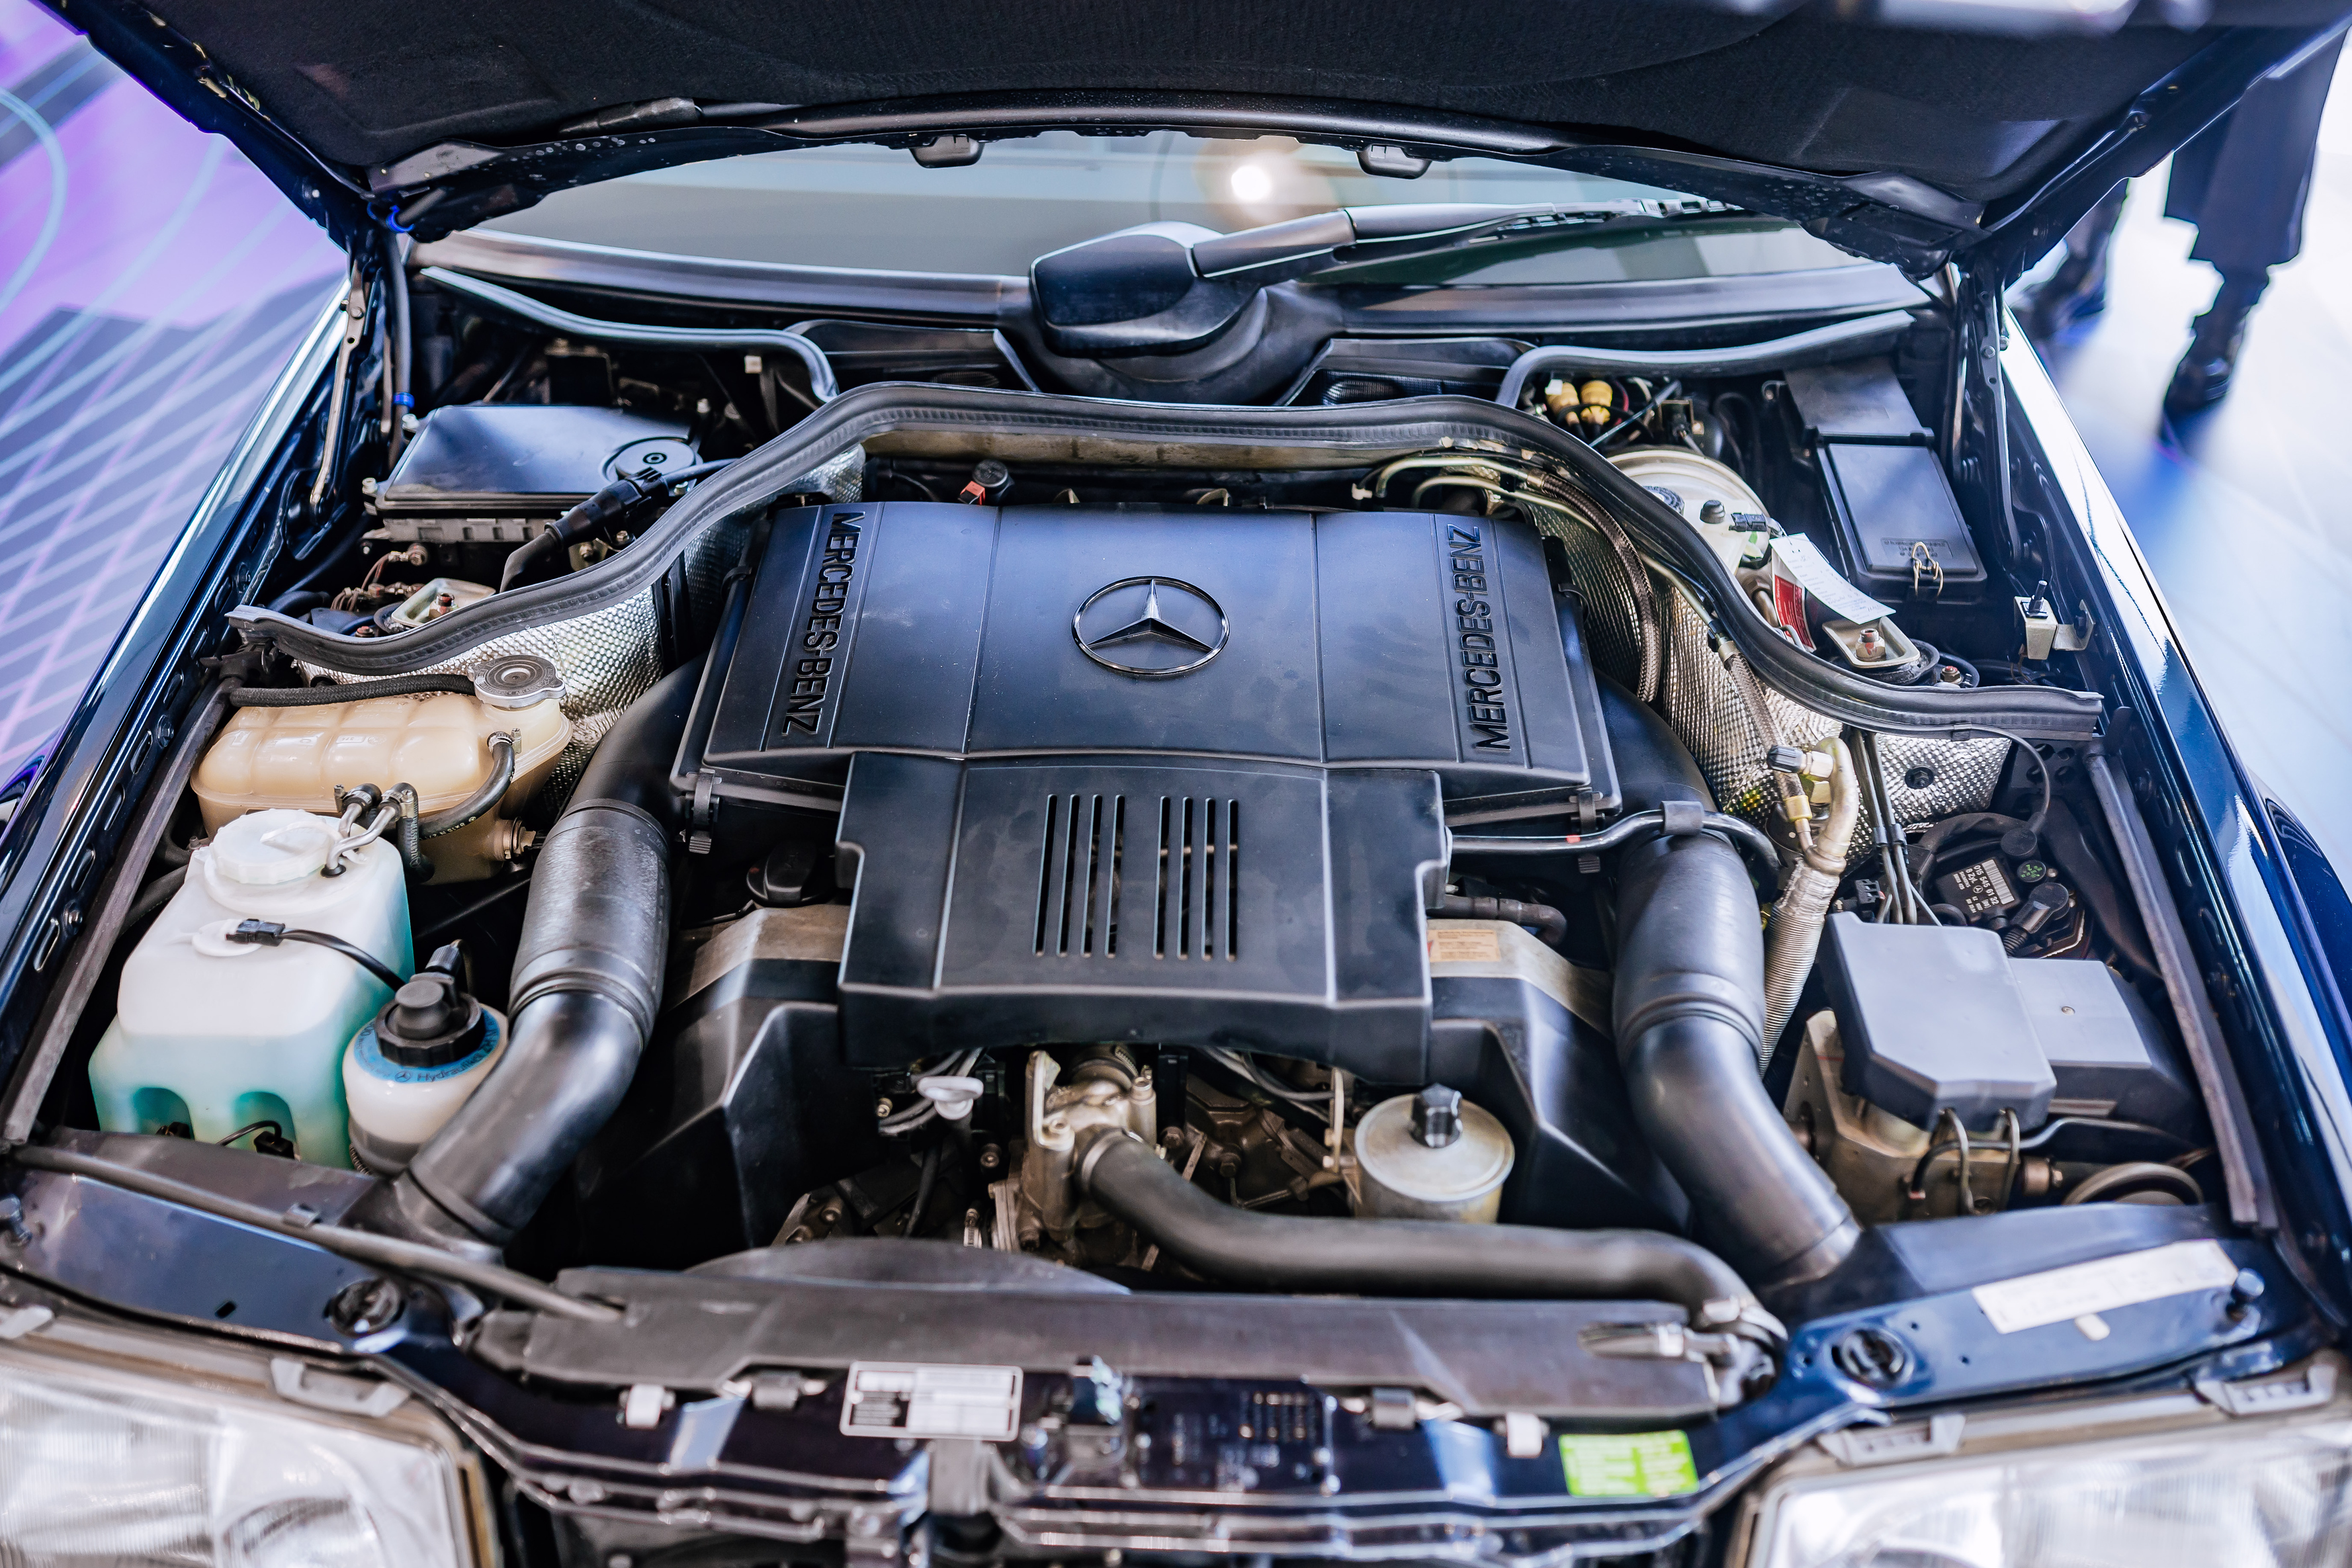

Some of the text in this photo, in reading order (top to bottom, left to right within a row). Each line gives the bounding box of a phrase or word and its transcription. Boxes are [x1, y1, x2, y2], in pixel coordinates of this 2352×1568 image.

[781, 511, 865, 736] MERCEDES-BENZ
[1447, 523, 1511, 752] MERCEDES-BENZ
[1974, 865, 1984, 875] 015
[1979, 876, 1991, 888] 545
[1989, 896, 1999, 905] 32
